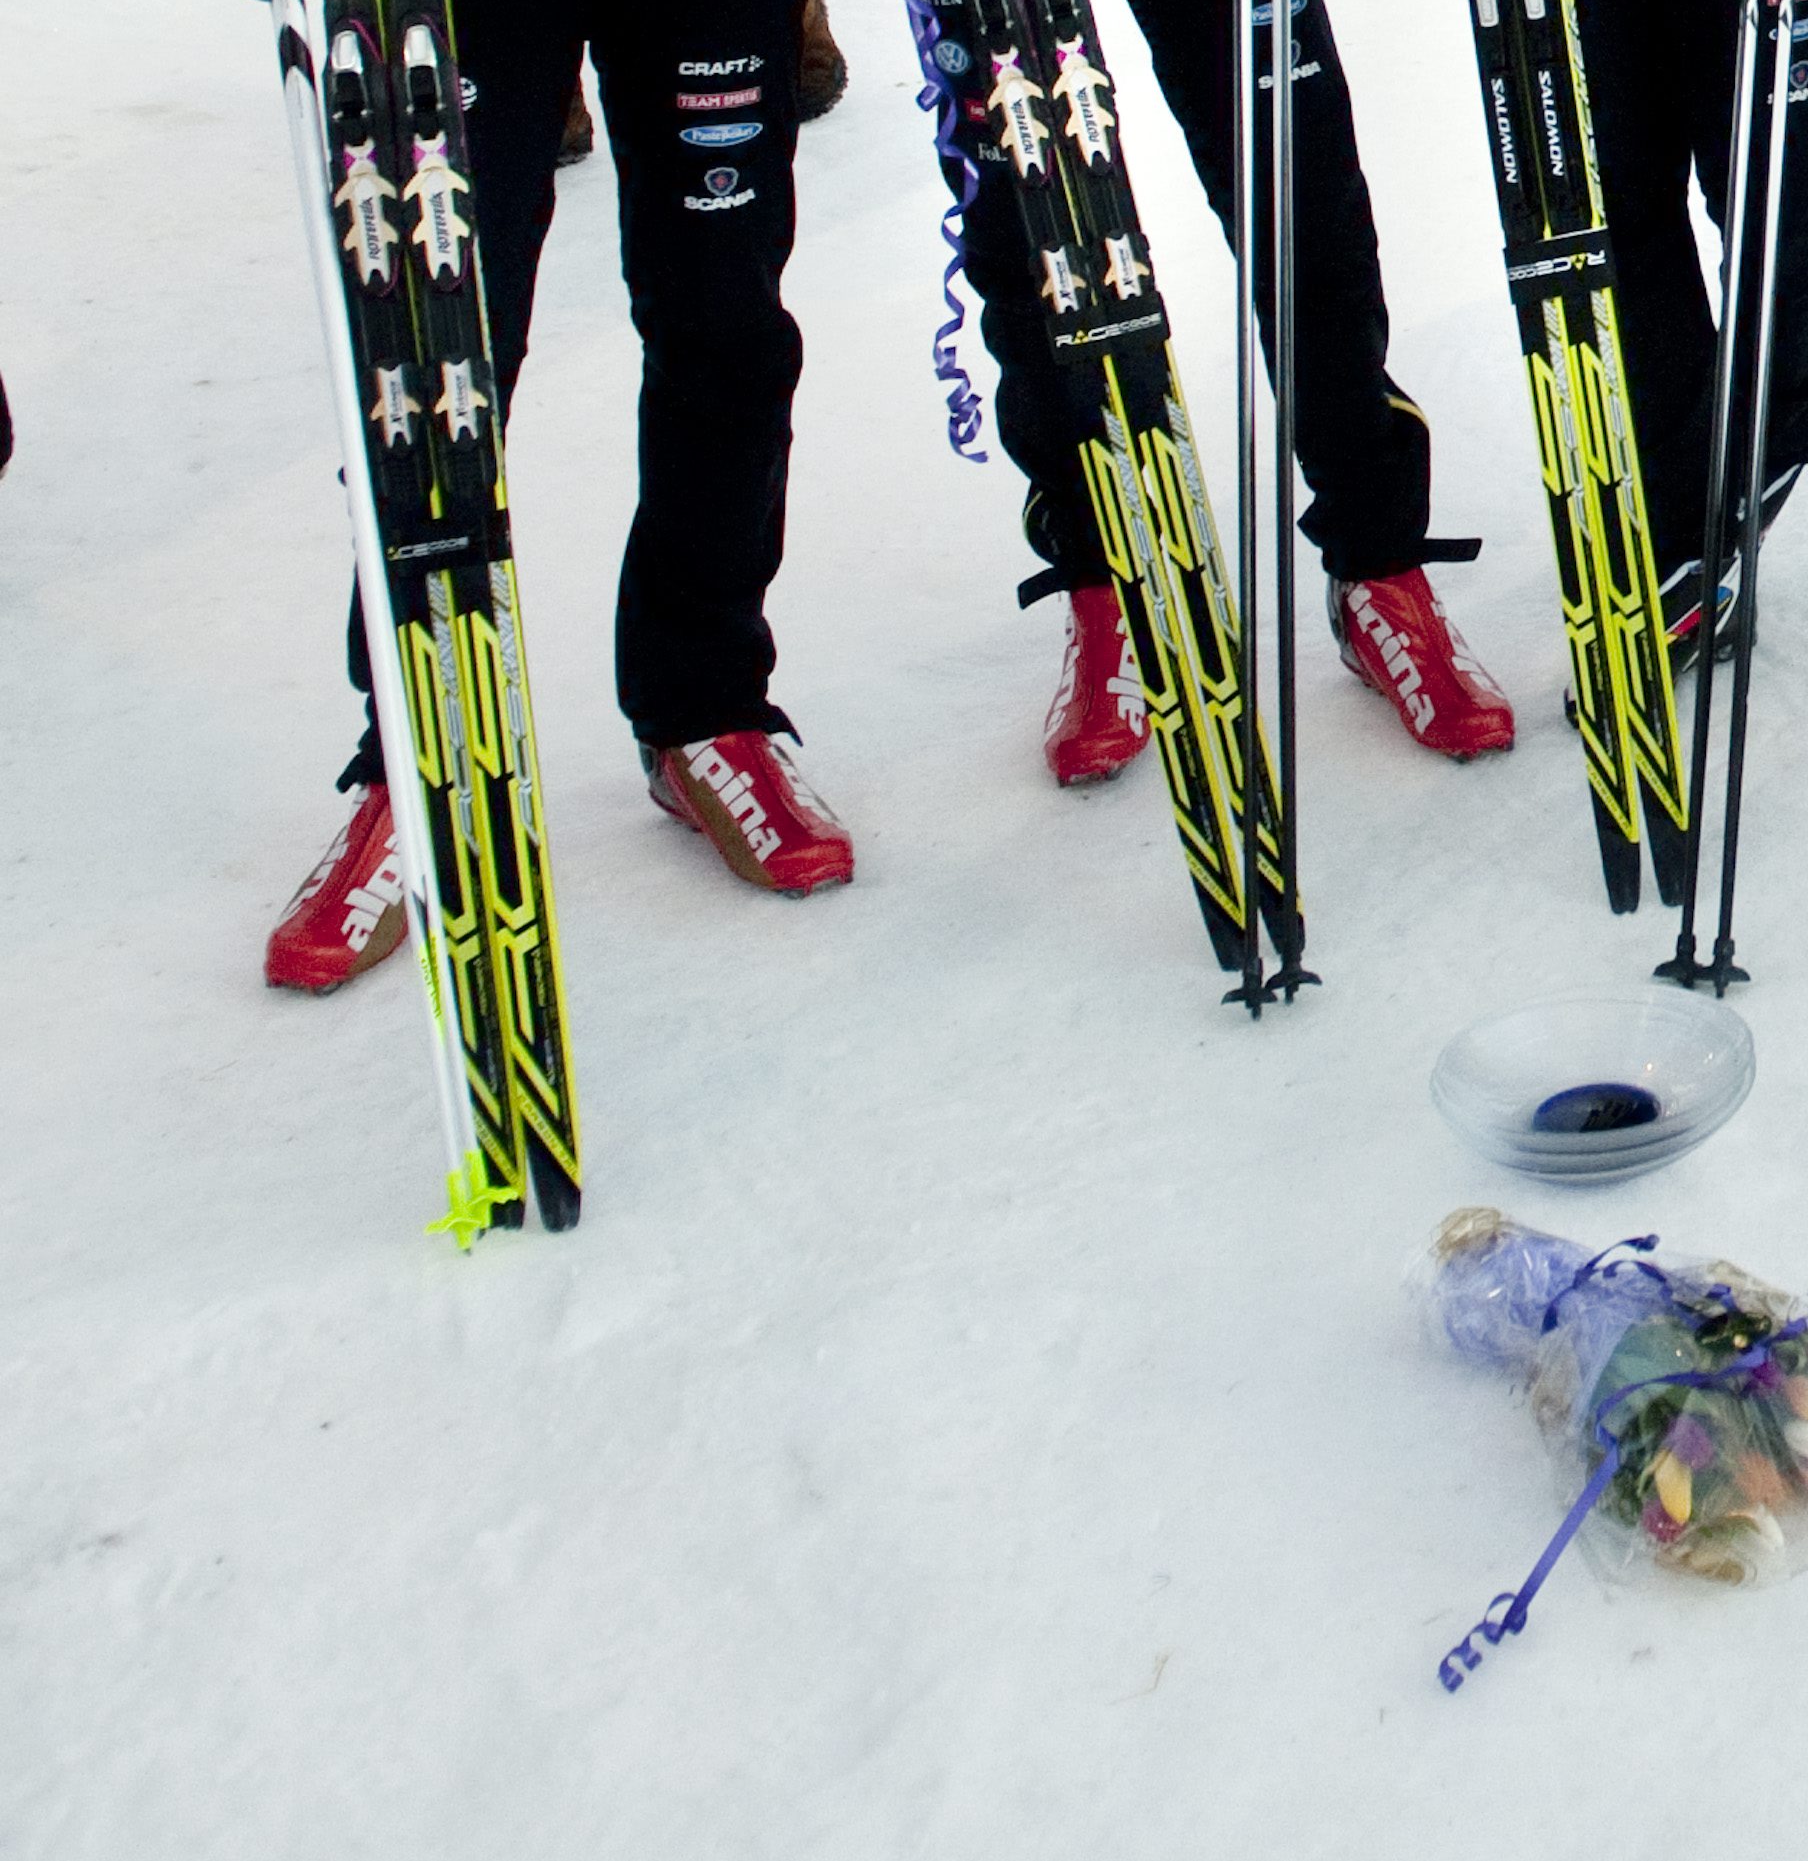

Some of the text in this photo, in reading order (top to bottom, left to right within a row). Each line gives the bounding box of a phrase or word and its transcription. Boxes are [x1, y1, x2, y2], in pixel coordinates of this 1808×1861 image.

[679, 59, 746, 77] CRAFT
[679, 93, 721, 108] TEAM
[1490, 77, 1519, 185] SALOMON
[1538, 69, 1566, 178] SALOMON
[683, 188, 757, 211] SCANIA
